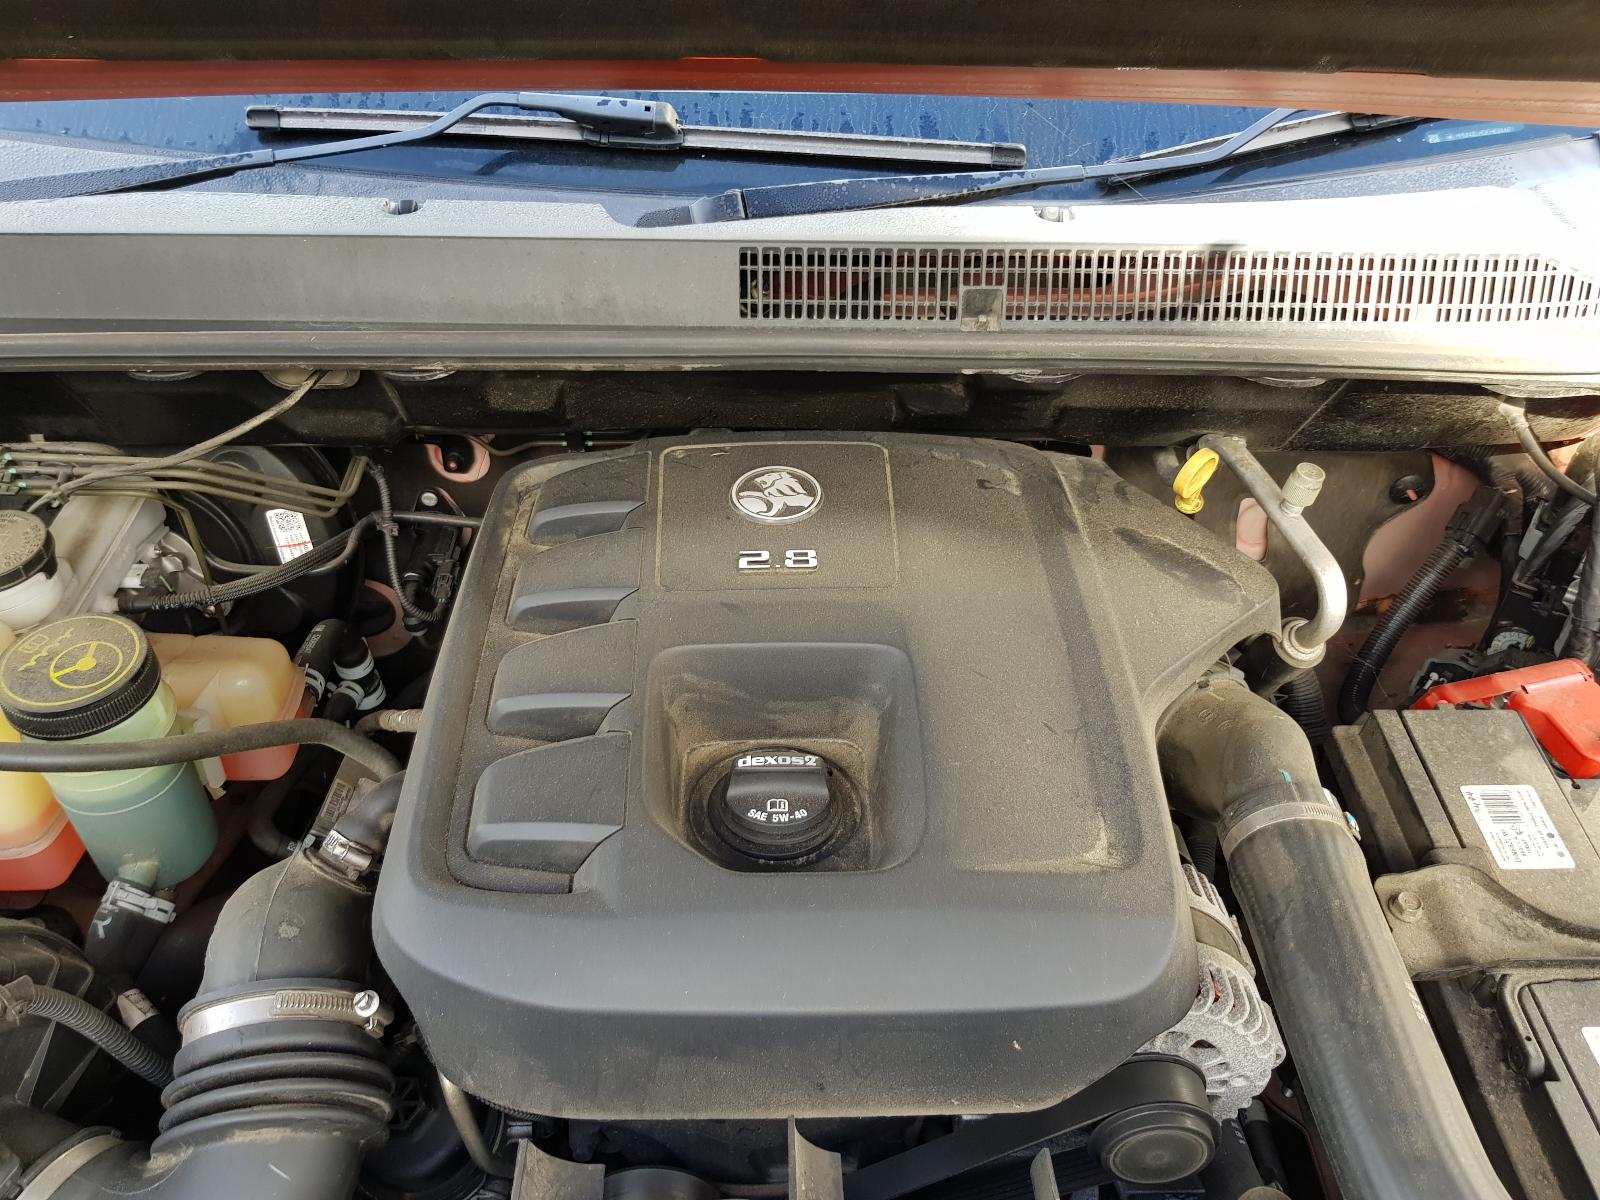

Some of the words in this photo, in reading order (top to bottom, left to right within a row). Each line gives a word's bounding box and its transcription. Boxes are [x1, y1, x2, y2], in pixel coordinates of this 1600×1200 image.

[738, 549, 818, 569] 2.8
[737, 755, 817, 767] dexos2
[747, 808, 768, 821] SAE
[772, 808, 808, 822] 5W-40
